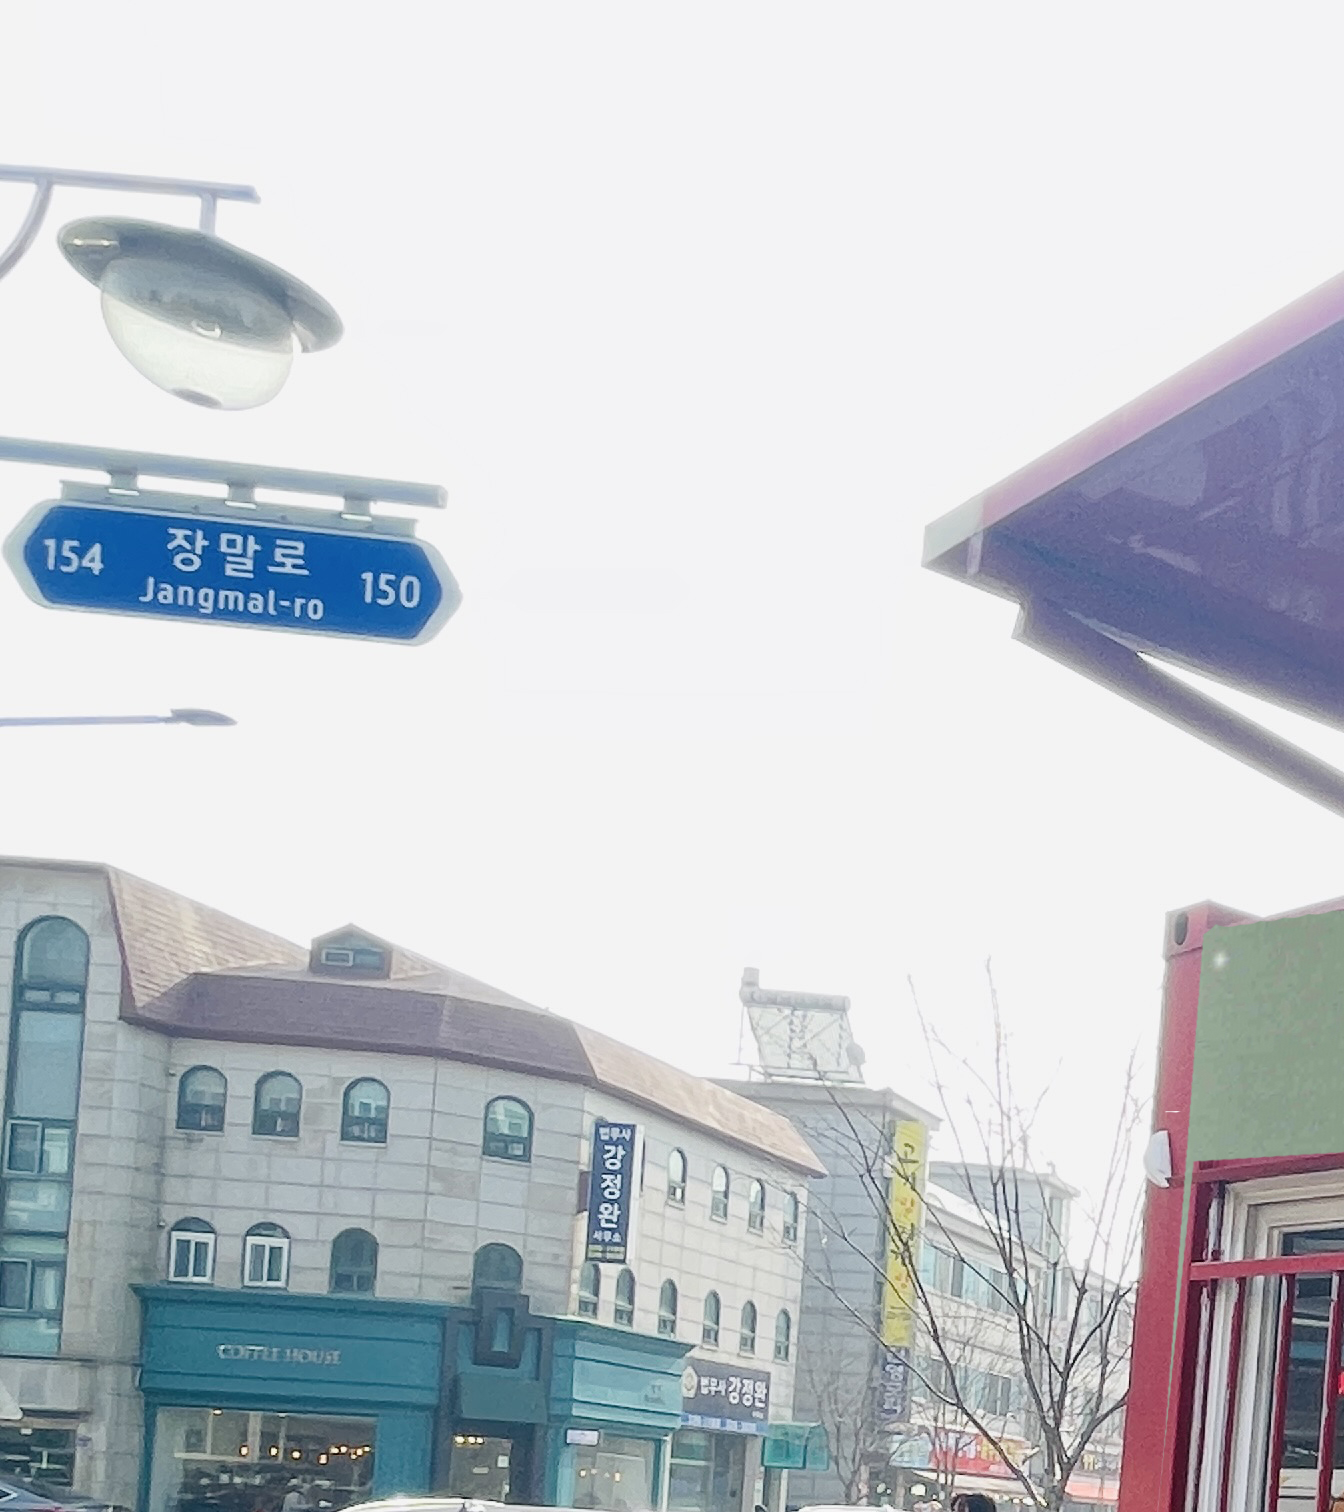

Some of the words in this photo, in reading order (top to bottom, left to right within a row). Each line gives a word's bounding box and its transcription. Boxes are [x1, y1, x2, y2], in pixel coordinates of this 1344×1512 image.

[43, 538, 104, 576] 154
[166, 527, 311, 579] 장말로
[139, 576, 324, 620] Jangmal-ro
[360, 571, 421, 608] 150
[598, 1144, 626, 1229] 강정완
[728, 1375, 767, 1408] 강정완
